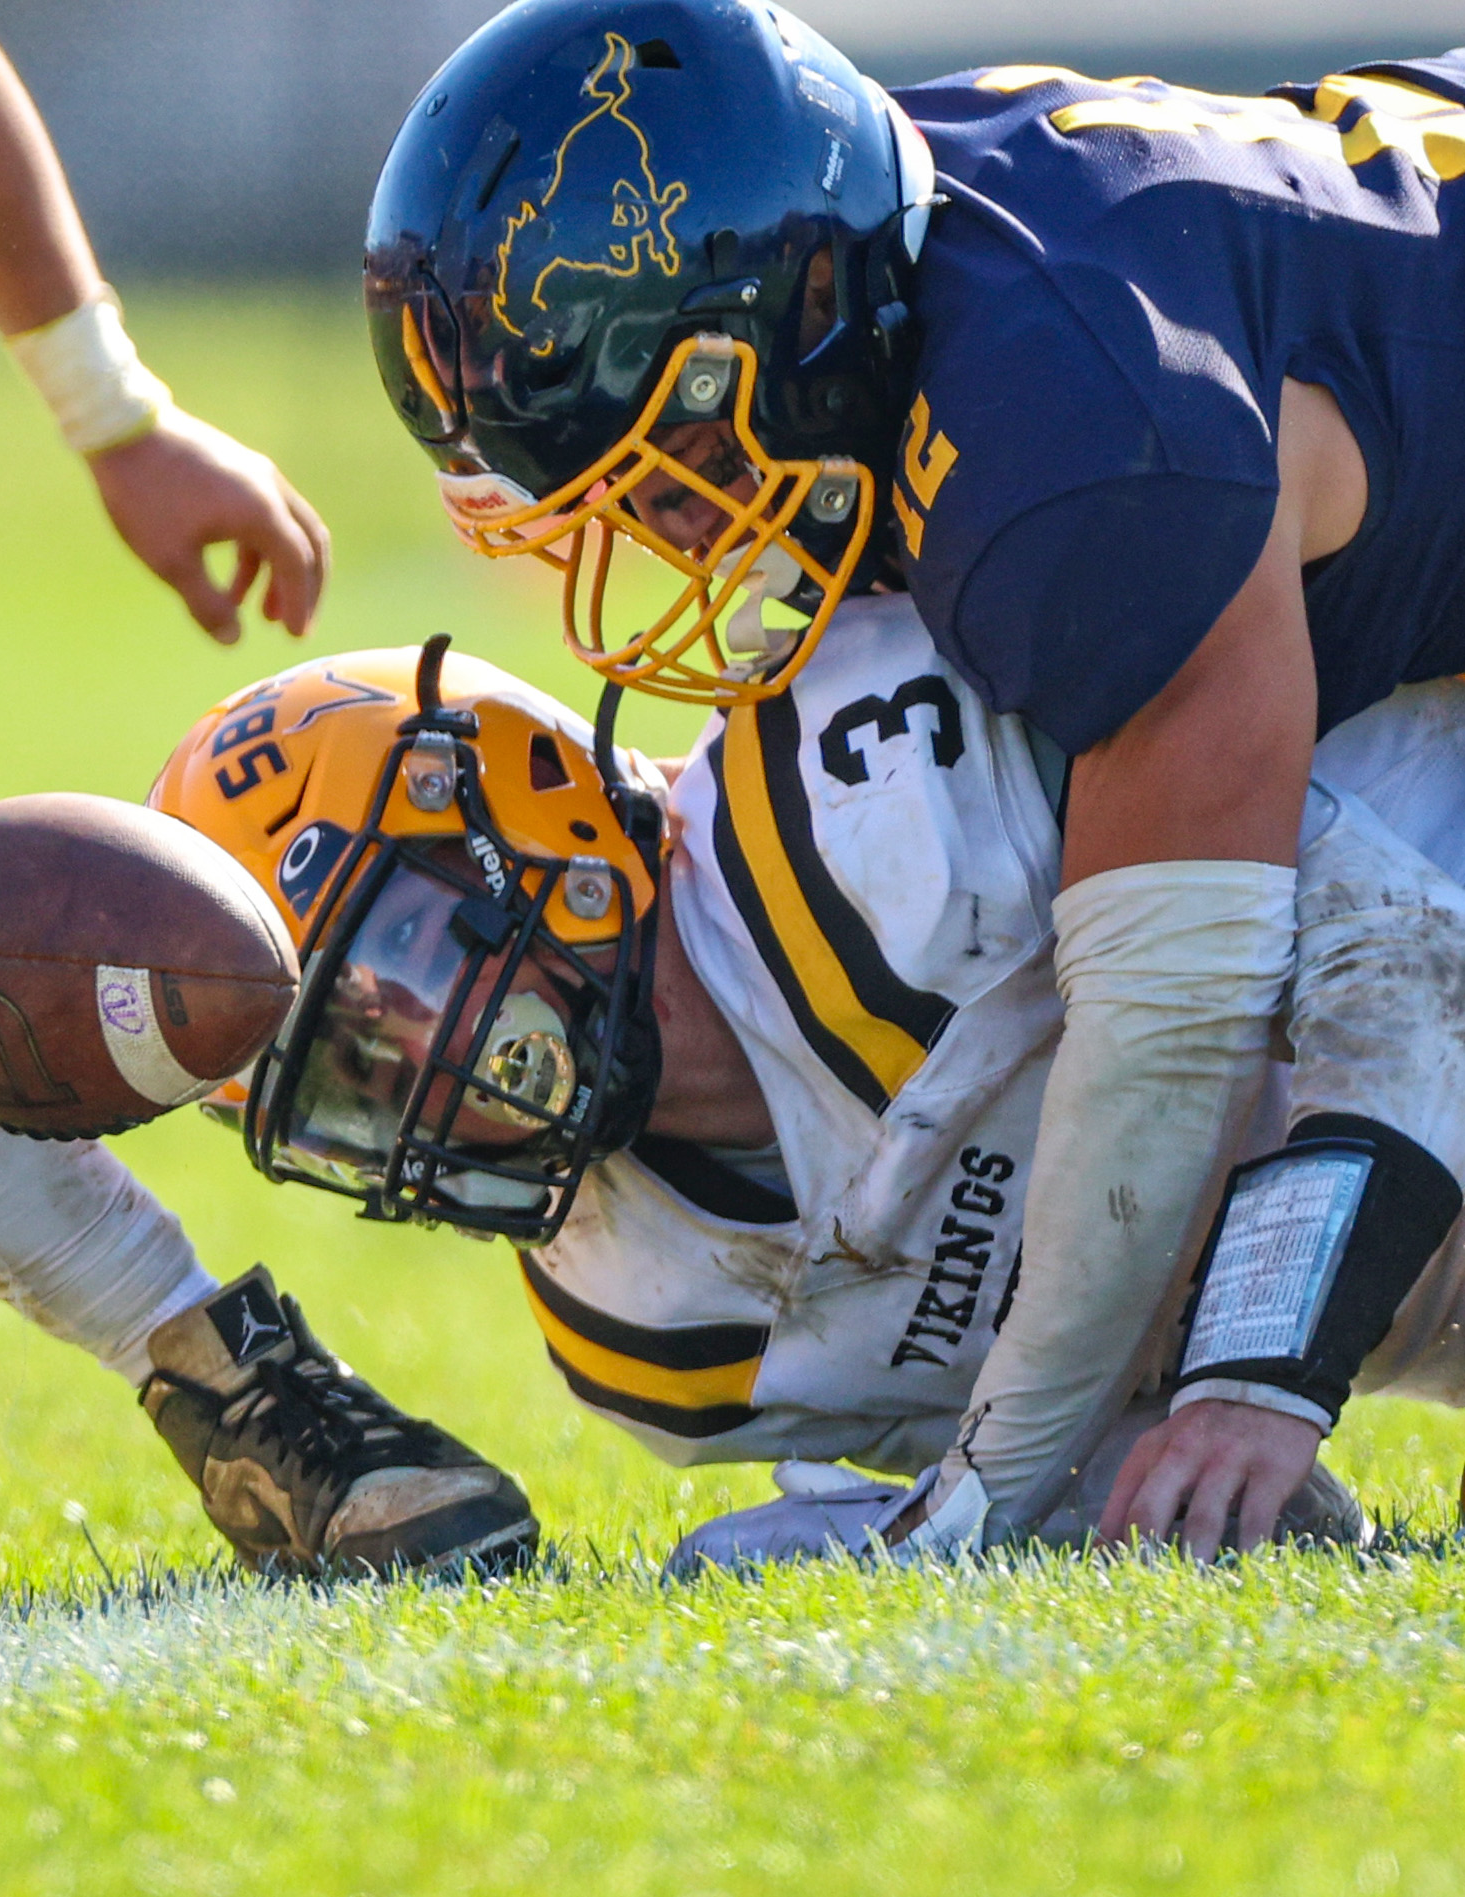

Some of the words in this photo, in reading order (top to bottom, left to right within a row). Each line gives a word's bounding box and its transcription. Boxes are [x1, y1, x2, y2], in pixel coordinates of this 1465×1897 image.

[819, 674, 965, 787] 3
[471, 834, 506, 899] dell
[890, 1145, 1016, 1367] VIKINGS
